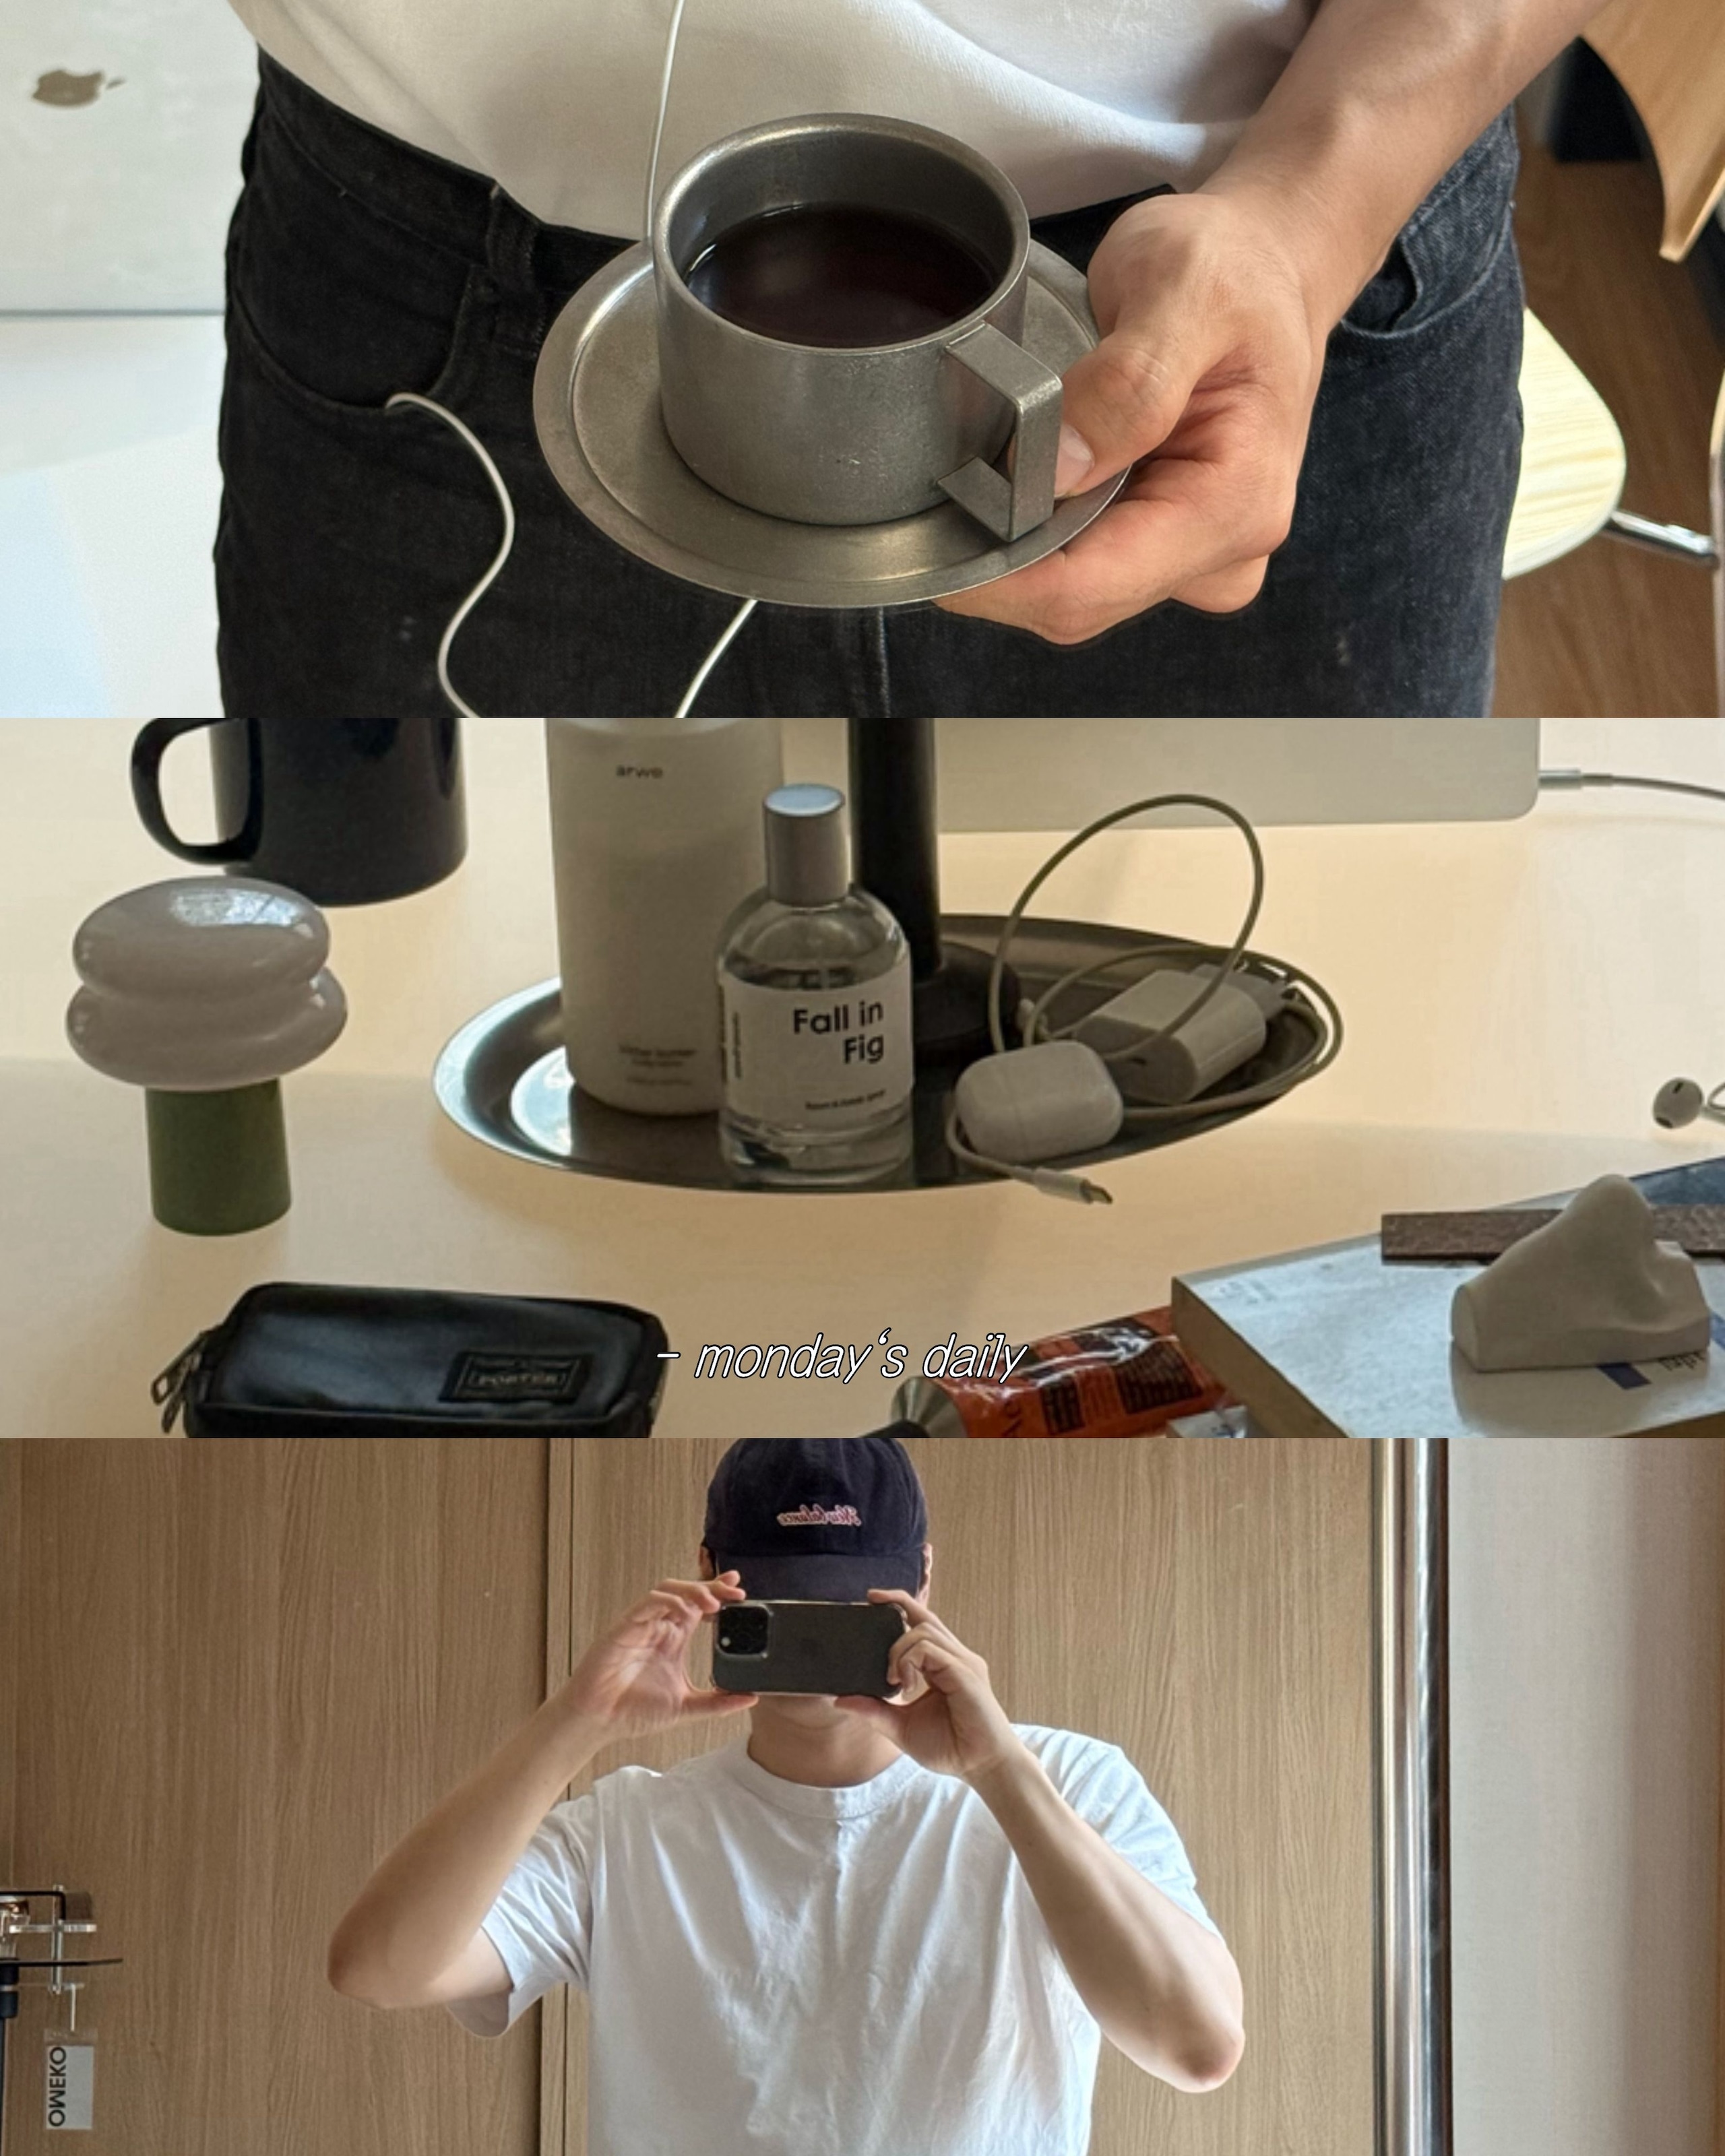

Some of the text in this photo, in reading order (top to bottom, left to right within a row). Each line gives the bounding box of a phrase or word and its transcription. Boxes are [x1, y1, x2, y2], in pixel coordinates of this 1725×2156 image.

[793, 1000, 883, 1035] Fall in
[844, 1033, 884, 1065] Fig
